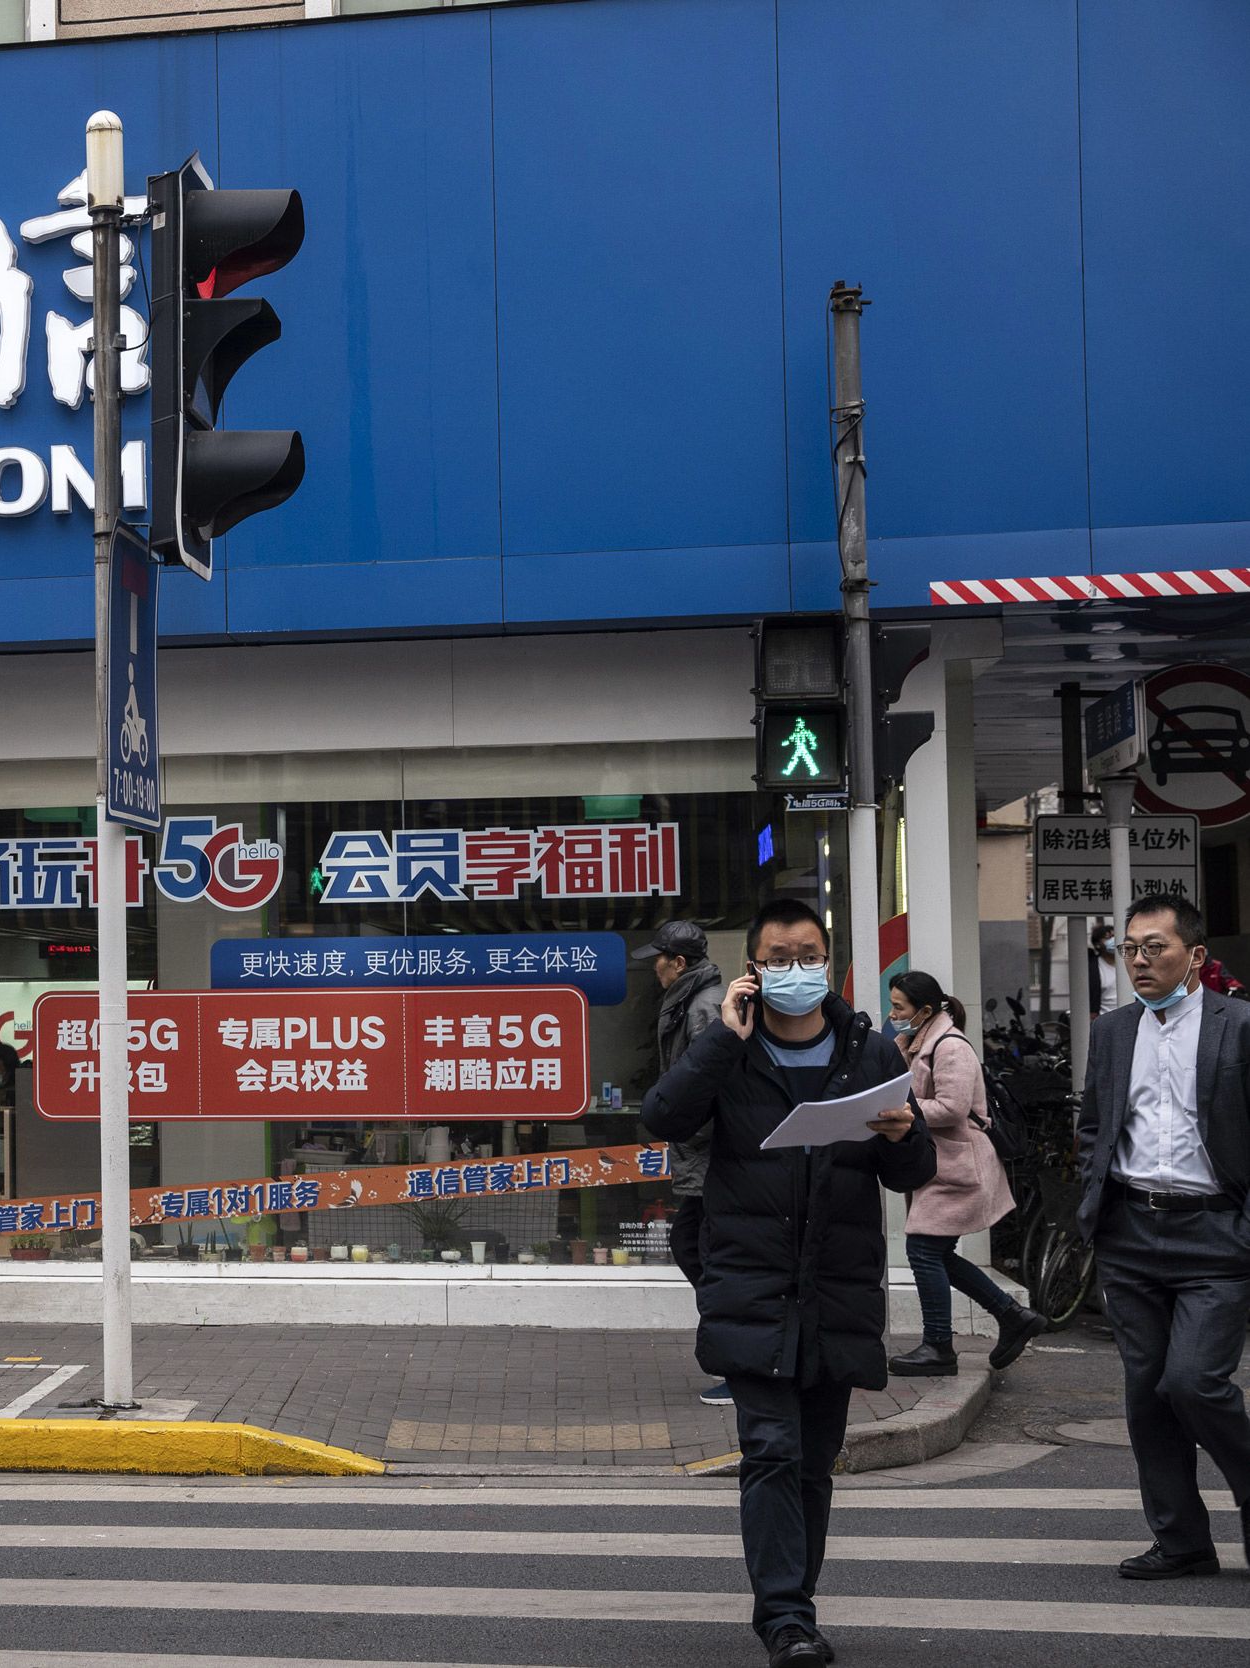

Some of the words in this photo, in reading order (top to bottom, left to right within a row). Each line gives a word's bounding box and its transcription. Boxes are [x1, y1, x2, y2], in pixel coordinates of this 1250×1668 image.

[114, 767, 156, 813] 7:00-19:00
[154, 817, 283, 911] 5G
[236, 841, 280, 859] hello
[320, 824, 680, 903] 会员享福利
[217, 1016, 386, 1050] 专属PLUS
[423, 1014, 561, 1048] 丰富5G
[235, 1060, 368, 1093] 会员权益
[423, 1059, 562, 1092] 潮酷应用
[407, 1157, 570, 1198] 通信管家上门
[160, 1178, 320, 1219] 专属1对1服务
